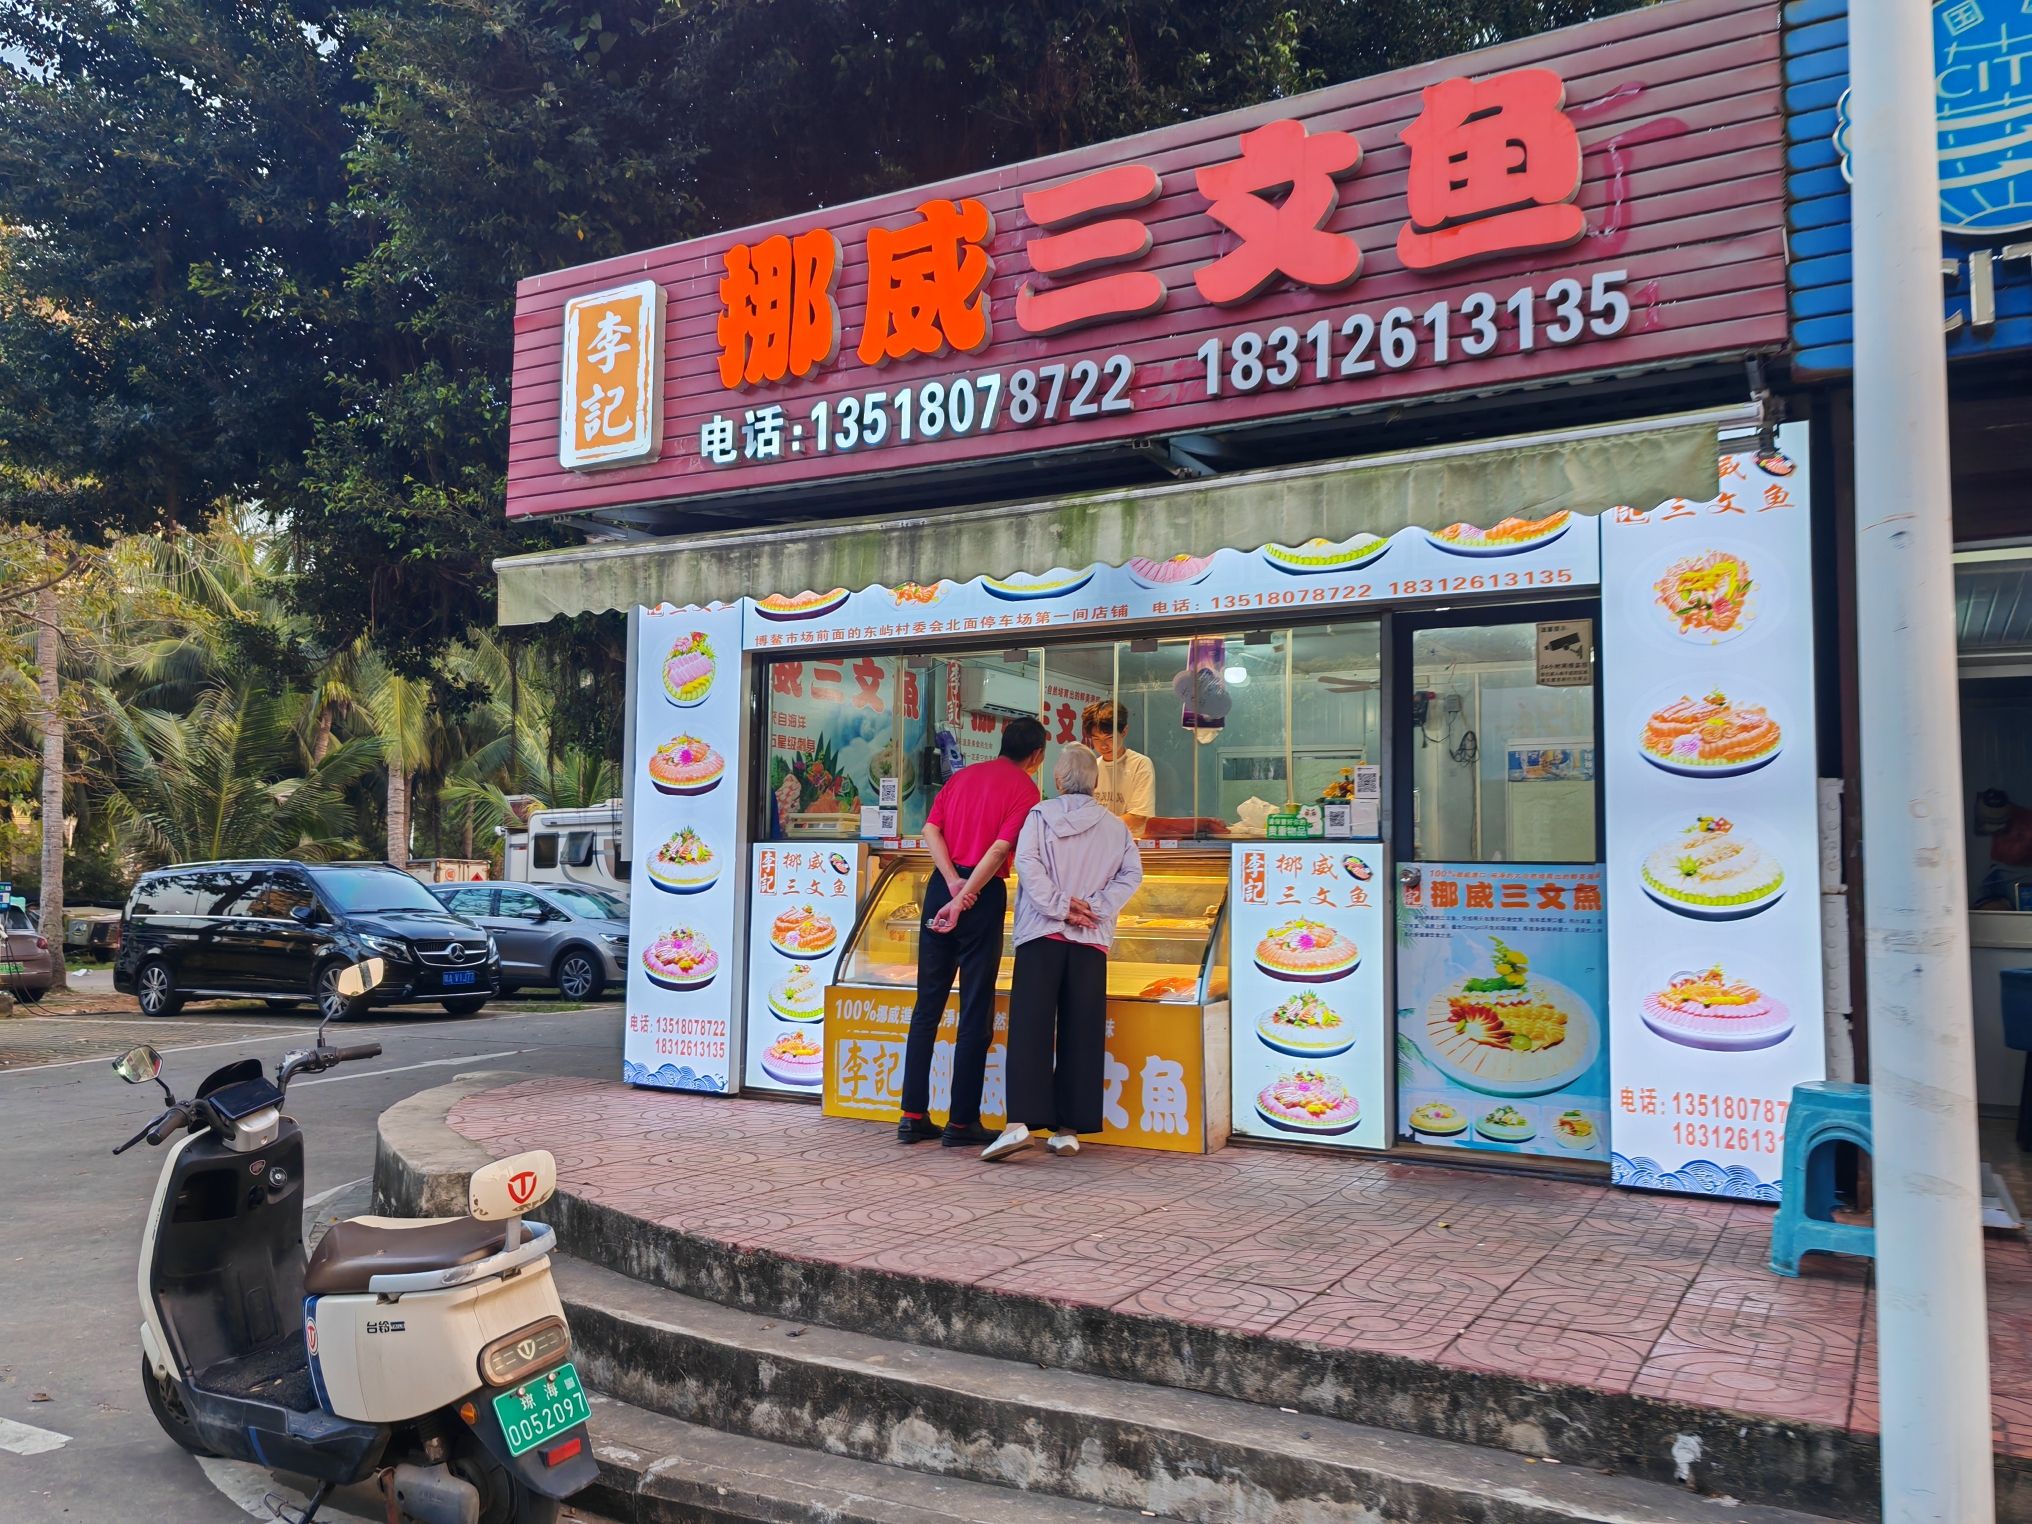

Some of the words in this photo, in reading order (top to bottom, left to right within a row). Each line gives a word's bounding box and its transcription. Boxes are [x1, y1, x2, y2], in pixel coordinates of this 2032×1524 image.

[716, 66, 1588, 392] 挪威三文鱼
[1197, 269, 1631, 396] 18312613135
[580, 310, 633, 440] 李記
[1389, 569, 1574, 596] 18312613135
[783, 851, 826, 874] 挪威
[1275, 853, 1338, 880] 挪威
[783, 878, 848, 898] 三文鱼
[1276, 885, 1372, 908] 三文鱼
[655, 1038, 725, 1058] 18312613135
[1673, 1122, 1785, 1153] 18312613
[508, 1391, 585, 1447] 0052097
